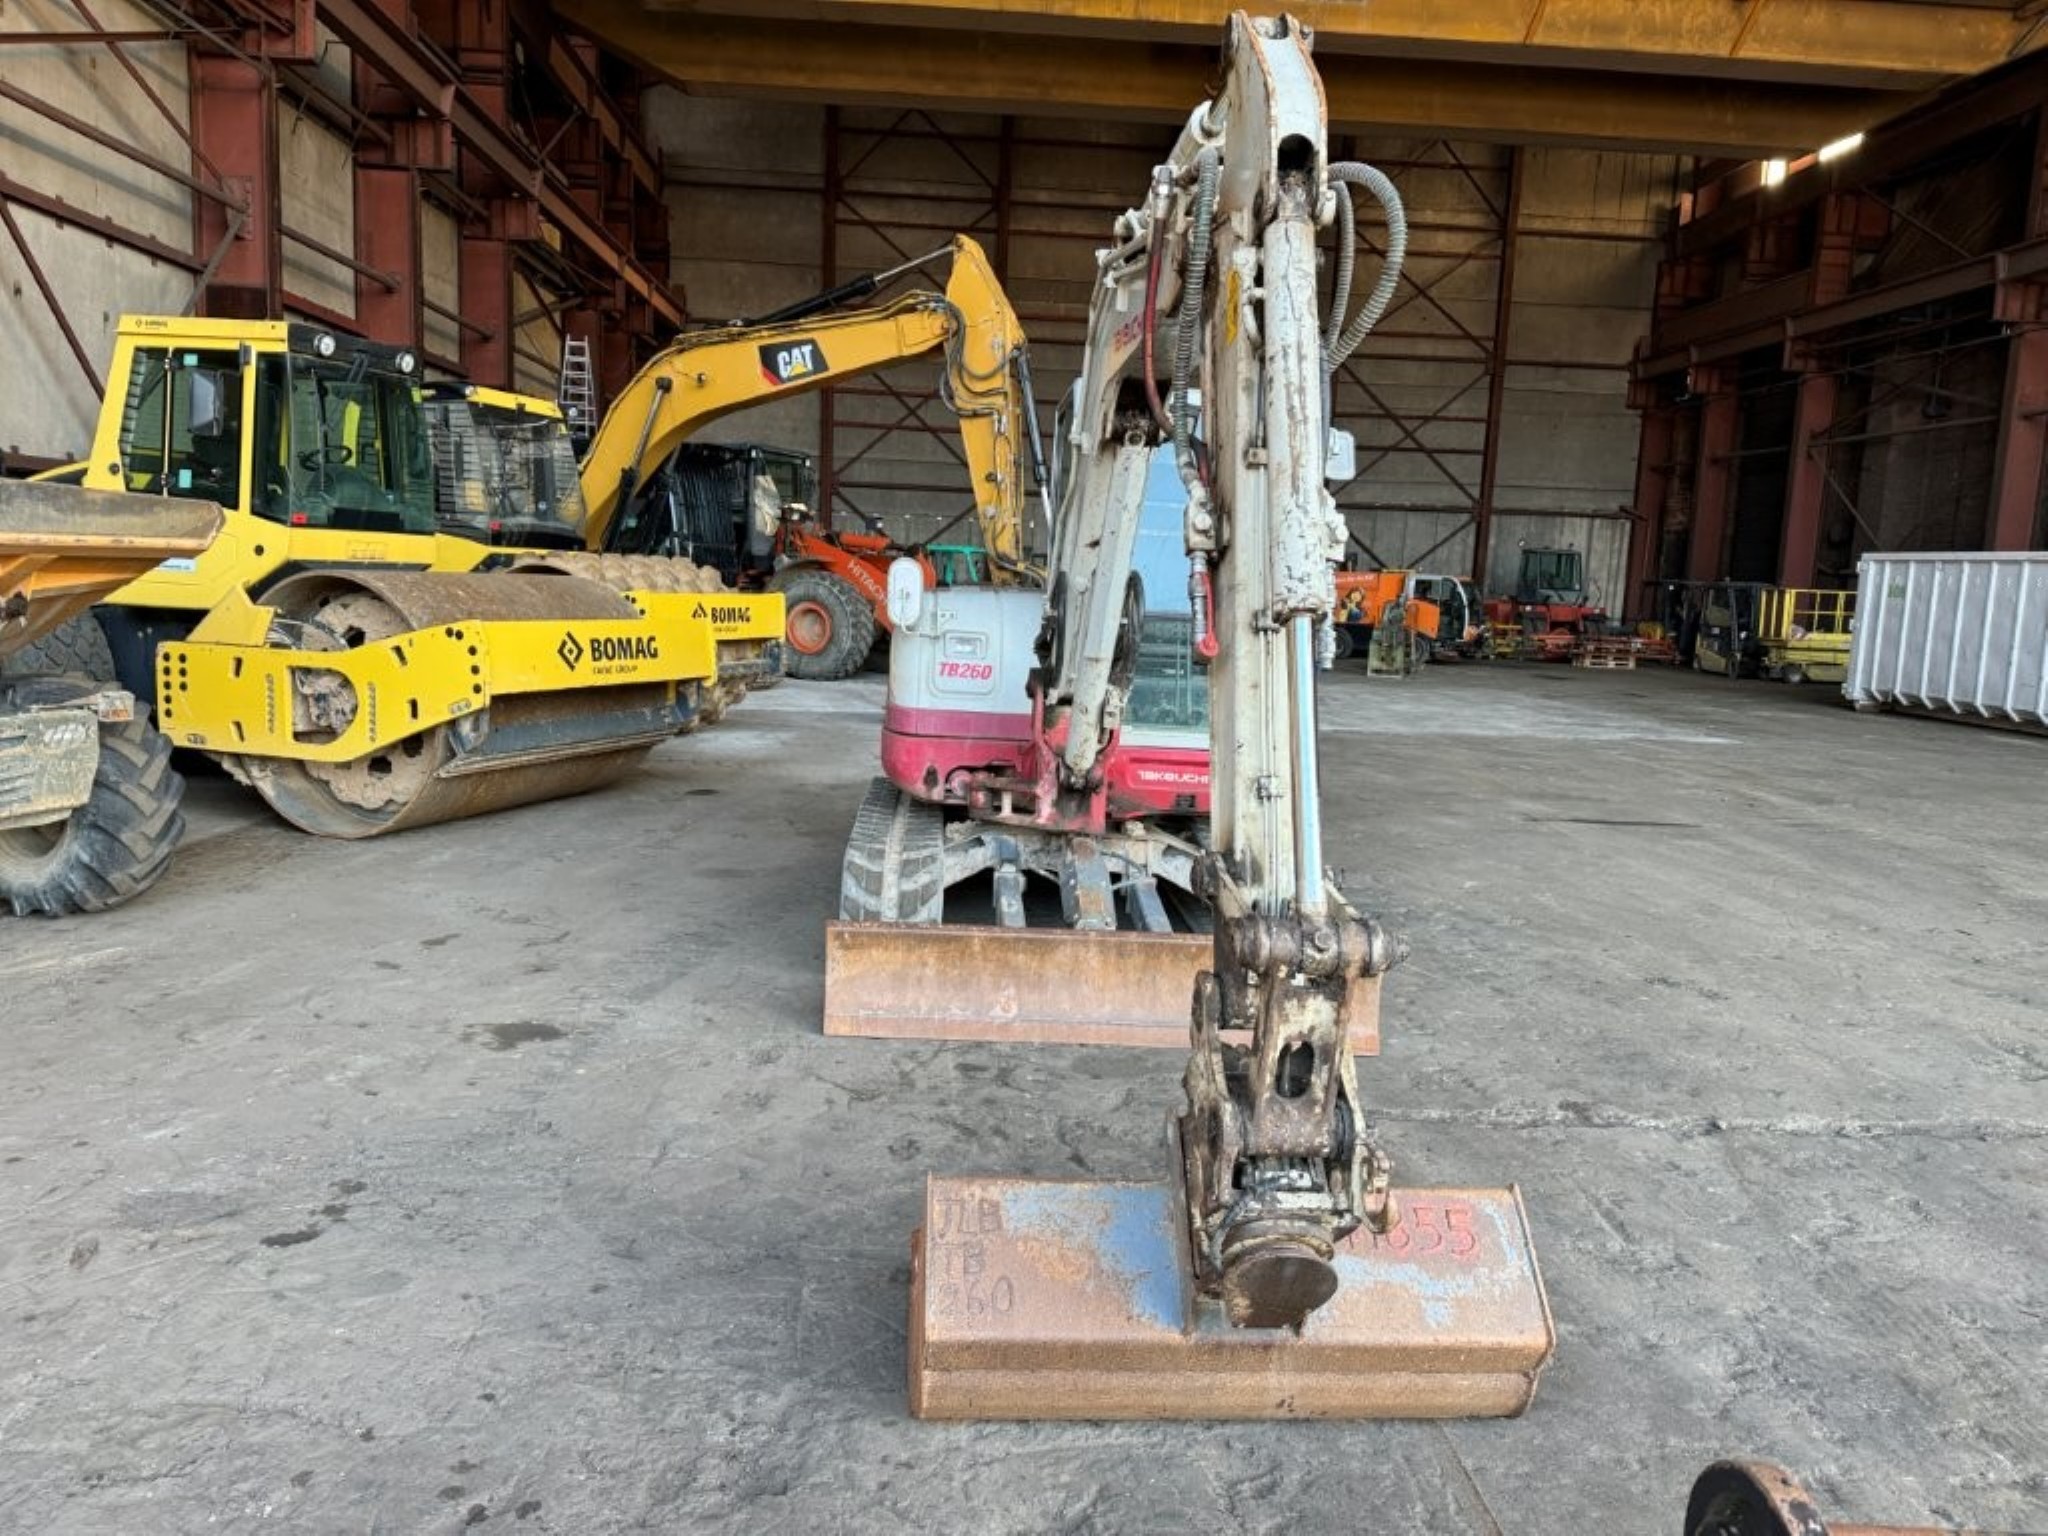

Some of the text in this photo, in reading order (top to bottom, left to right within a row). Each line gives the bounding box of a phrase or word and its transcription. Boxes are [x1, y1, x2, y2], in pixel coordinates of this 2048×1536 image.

[777, 344, 813, 378] CAT
[847, 559, 888, 606] HITACH
[711, 606, 751, 624] BOMAG
[590, 636, 658, 662] BOMAG
[939, 662, 992, 680] TB260
